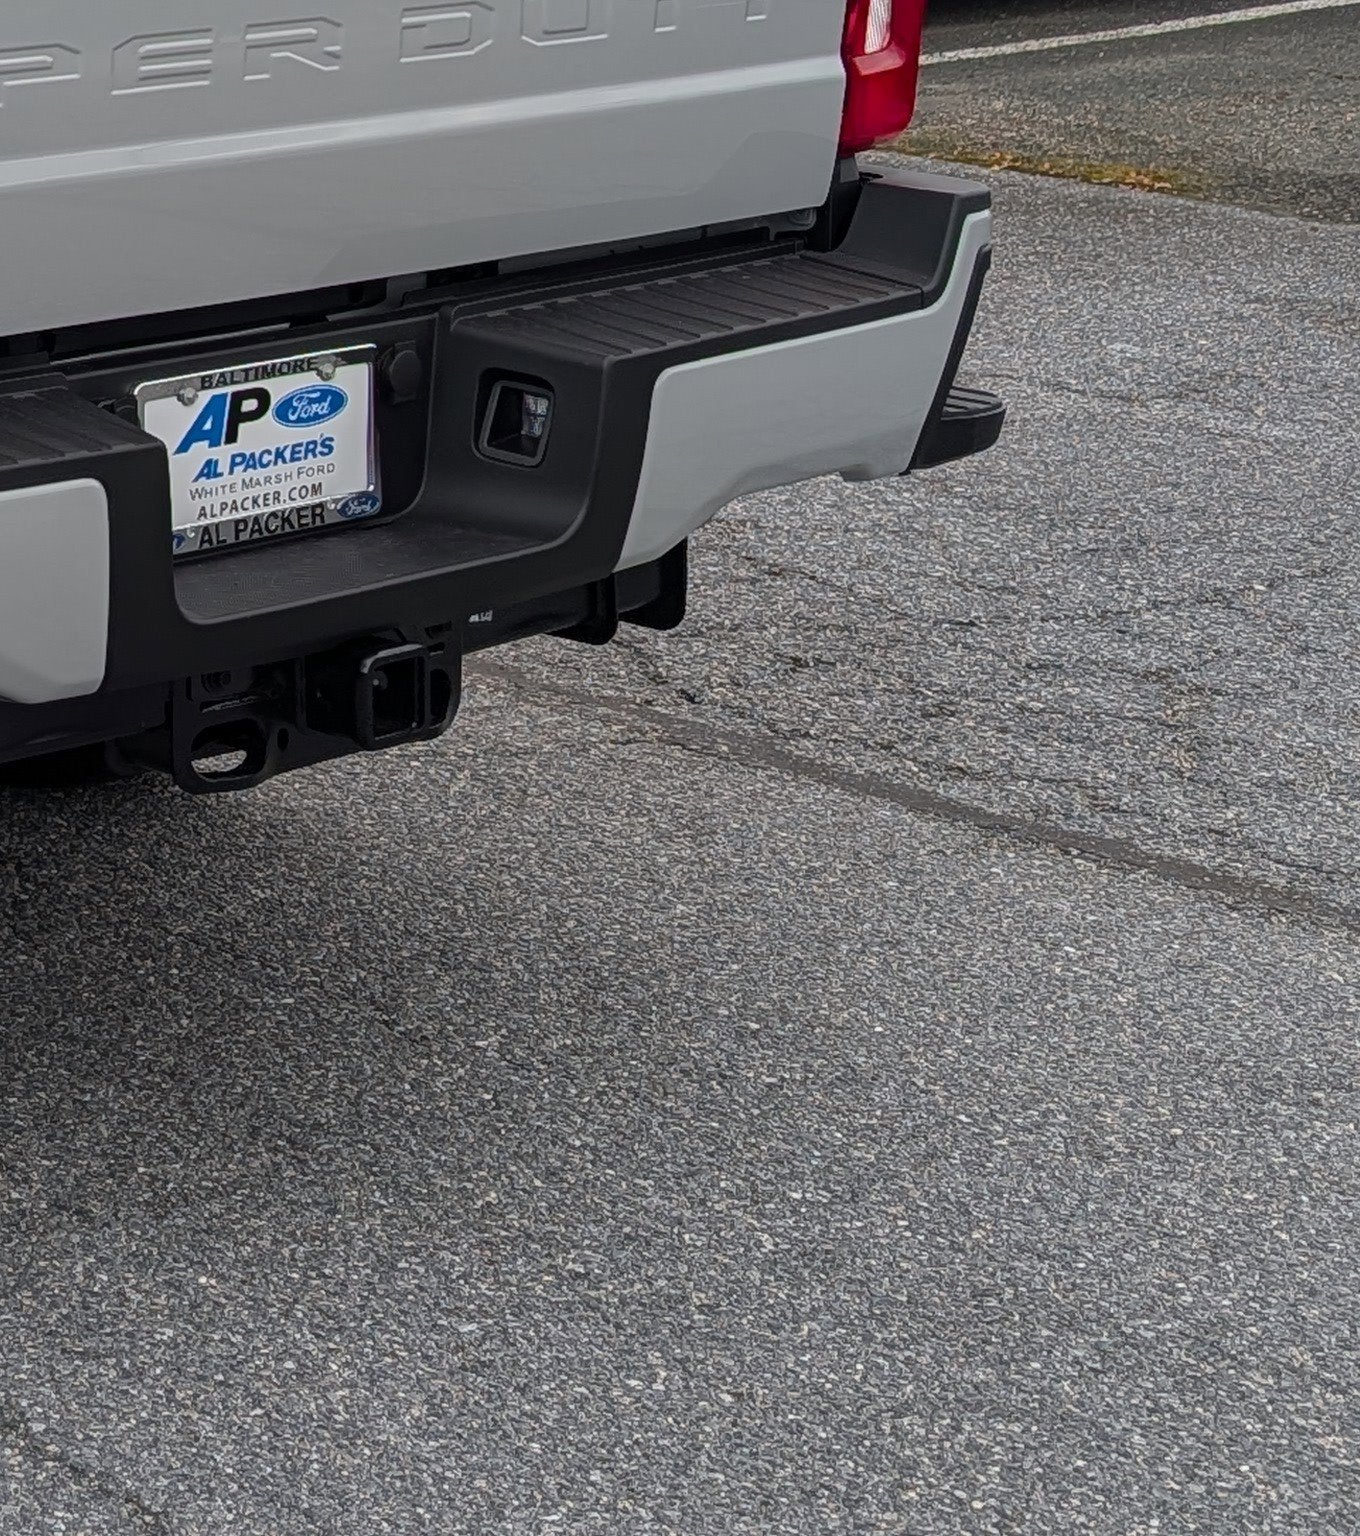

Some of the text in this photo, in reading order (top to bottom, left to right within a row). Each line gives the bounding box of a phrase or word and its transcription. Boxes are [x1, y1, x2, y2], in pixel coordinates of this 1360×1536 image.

[200, 358, 317, 390] BALTIMORE
[174, 386, 272, 455] AP
[288, 391, 333, 422] Ford
[191, 433, 335, 483] AL PACKER'S
[196, 481, 323, 521] ALPACKER.COM
[199, 524, 228, 550] AL
[233, 502, 326, 542] PACKER
